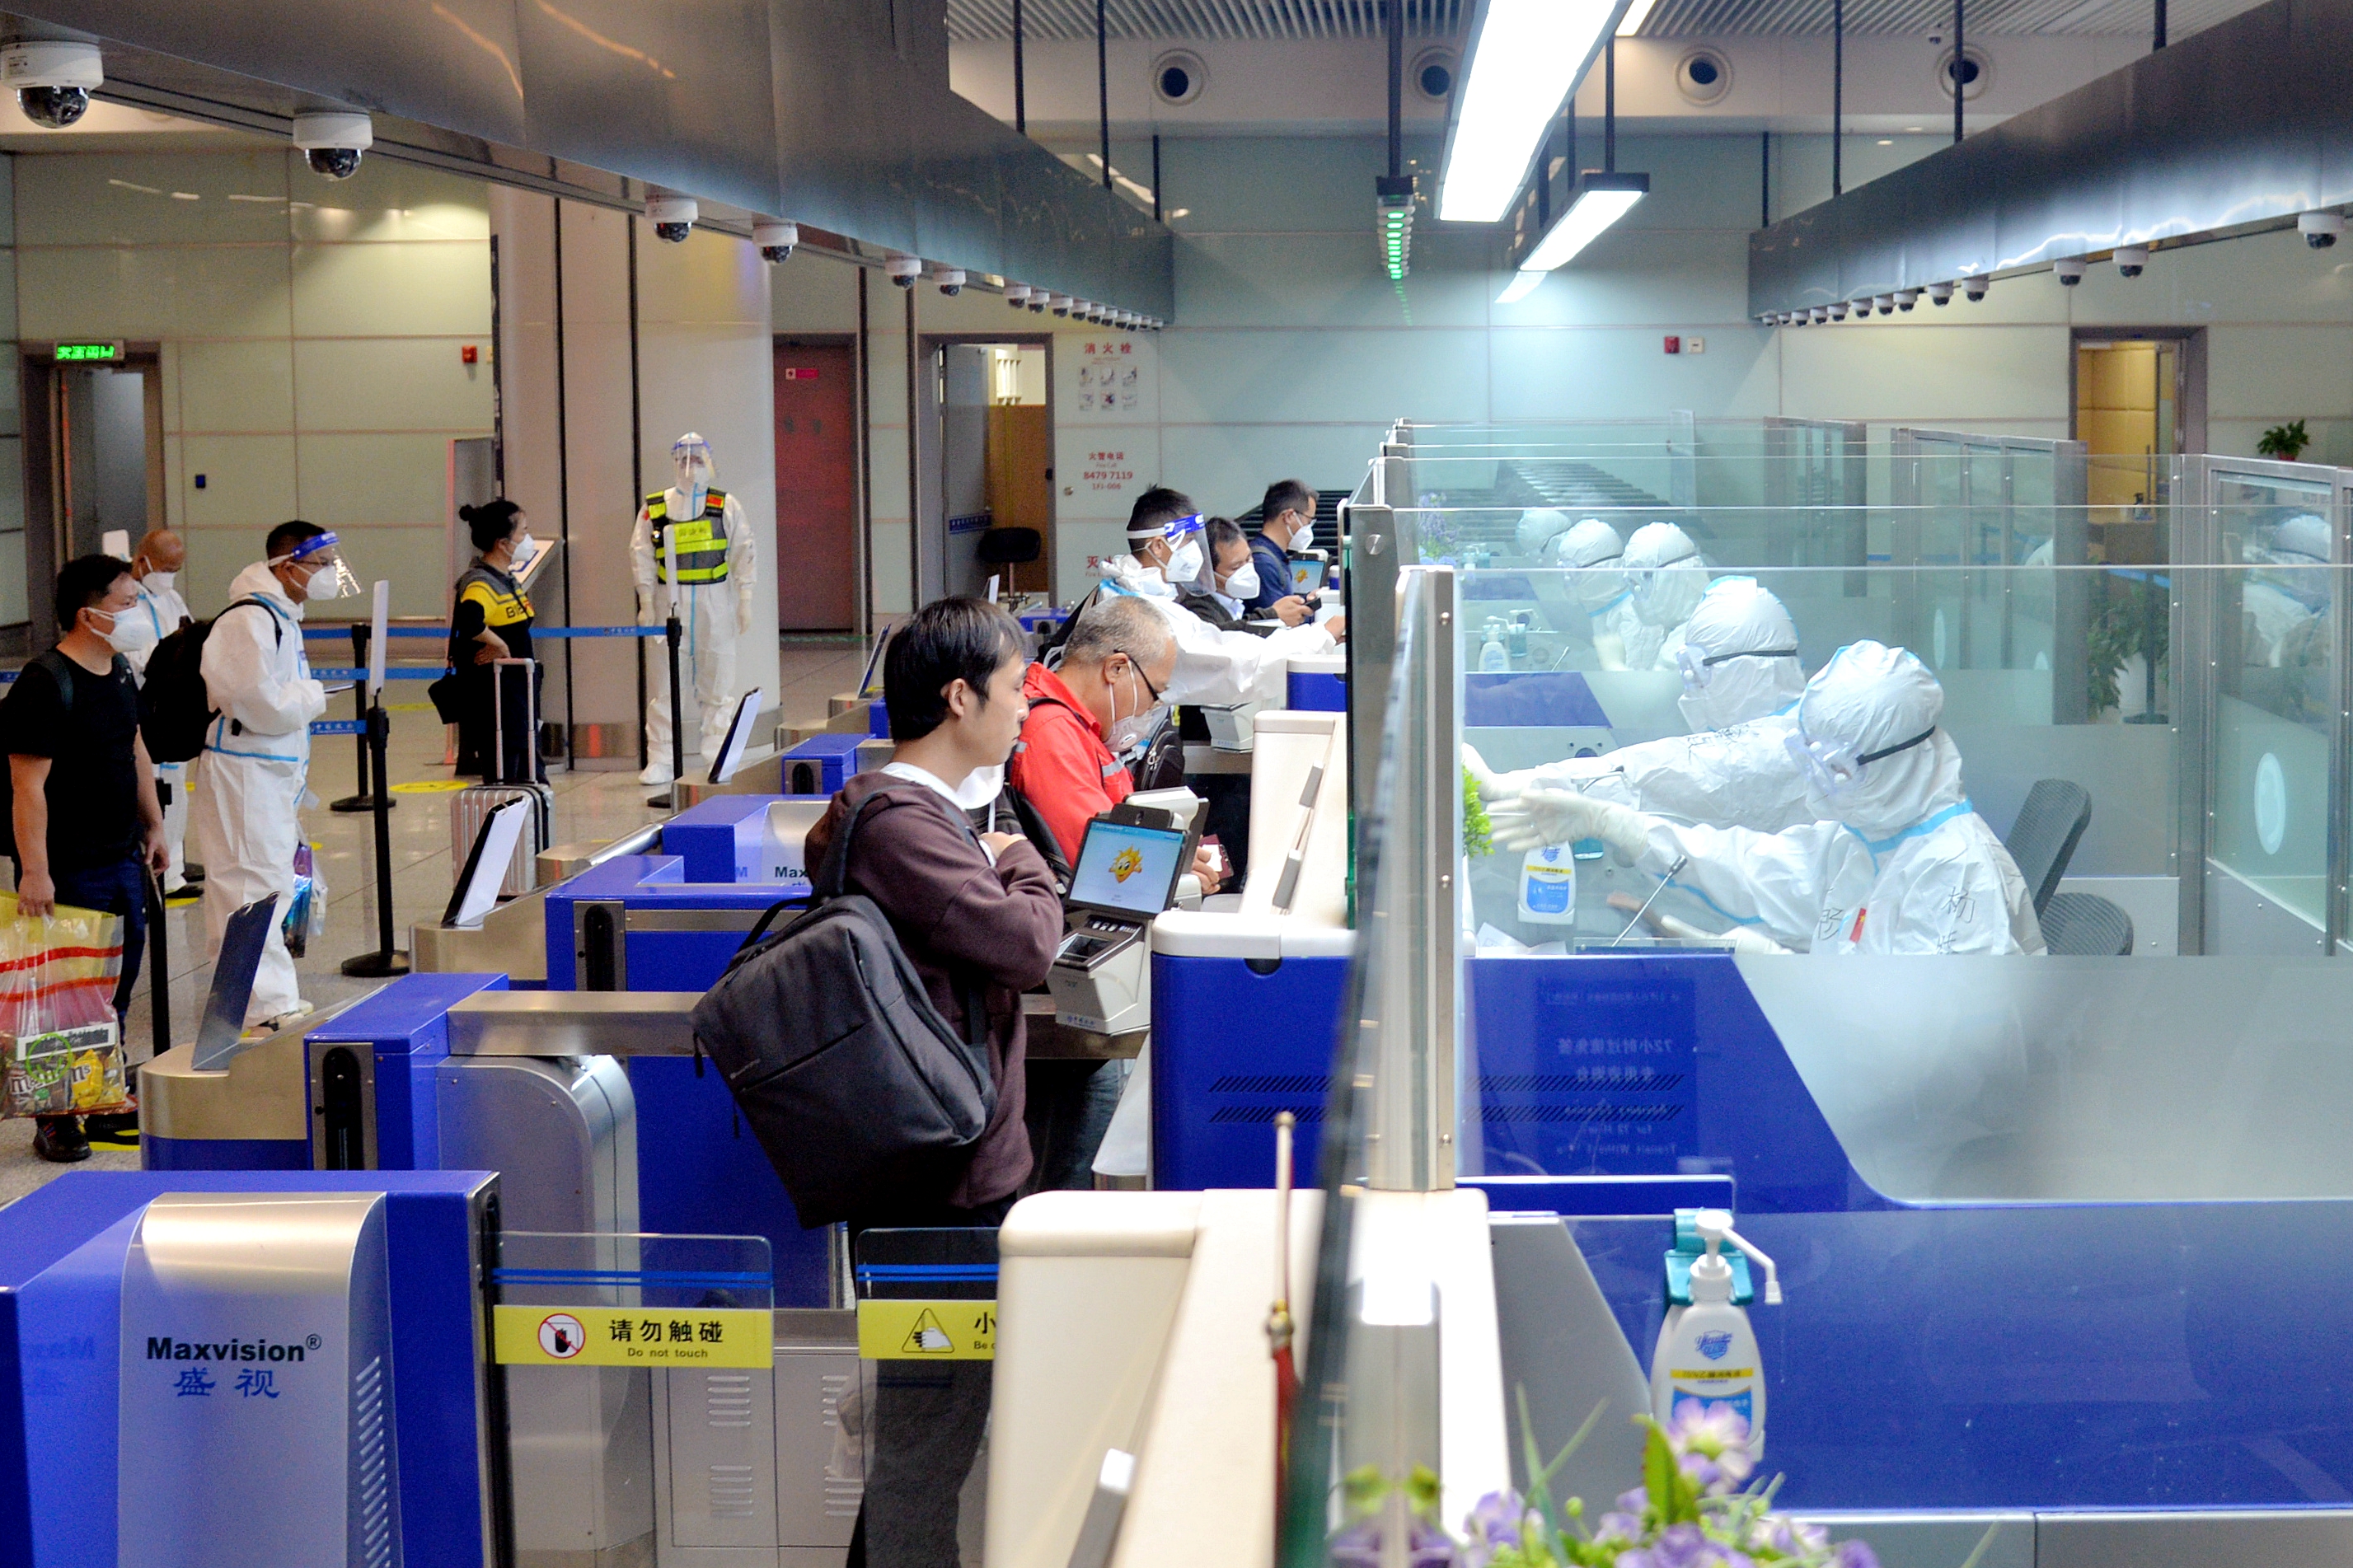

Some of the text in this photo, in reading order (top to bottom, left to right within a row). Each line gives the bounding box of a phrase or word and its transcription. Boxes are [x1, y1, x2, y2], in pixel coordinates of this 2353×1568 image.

[1083, 470, 1133, 480] 8479 7119
[609, 1319, 723, 1342] 请勿触碰
[627, 1347, 708, 1358] Do not touch
[173, 1366, 280, 1398] 盛视
